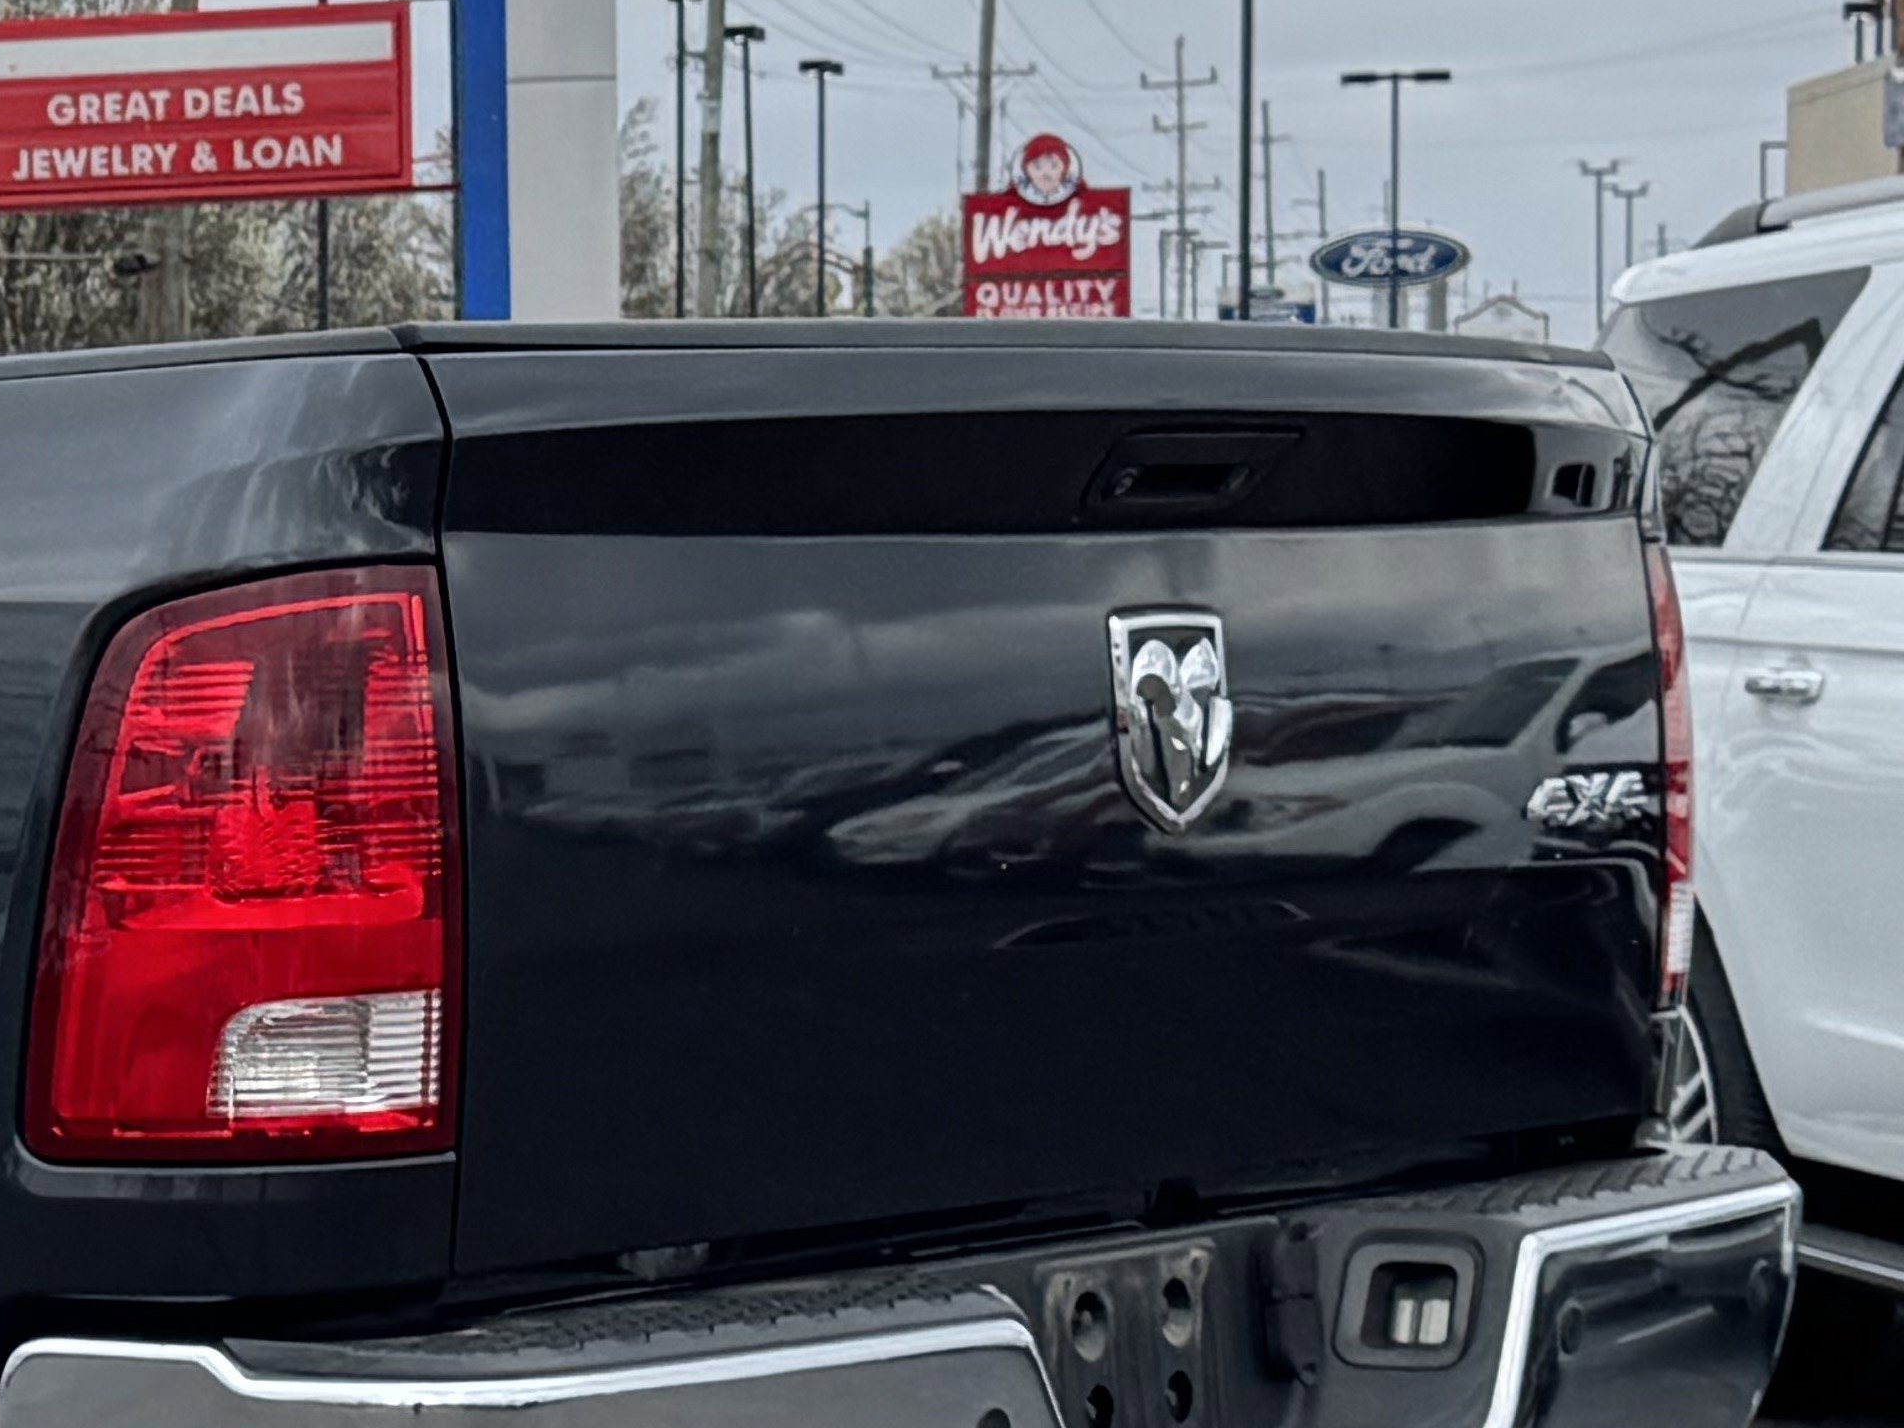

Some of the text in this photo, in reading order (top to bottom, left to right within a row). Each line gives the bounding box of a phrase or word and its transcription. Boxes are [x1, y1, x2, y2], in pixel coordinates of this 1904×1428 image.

[47, 82, 305, 127] GREAT DEALS
[12, 132, 343, 182] JEWELRY & LOAN
[972, 197, 1122, 264] Wendy's
[975, 278, 1117, 308] QUALITY
